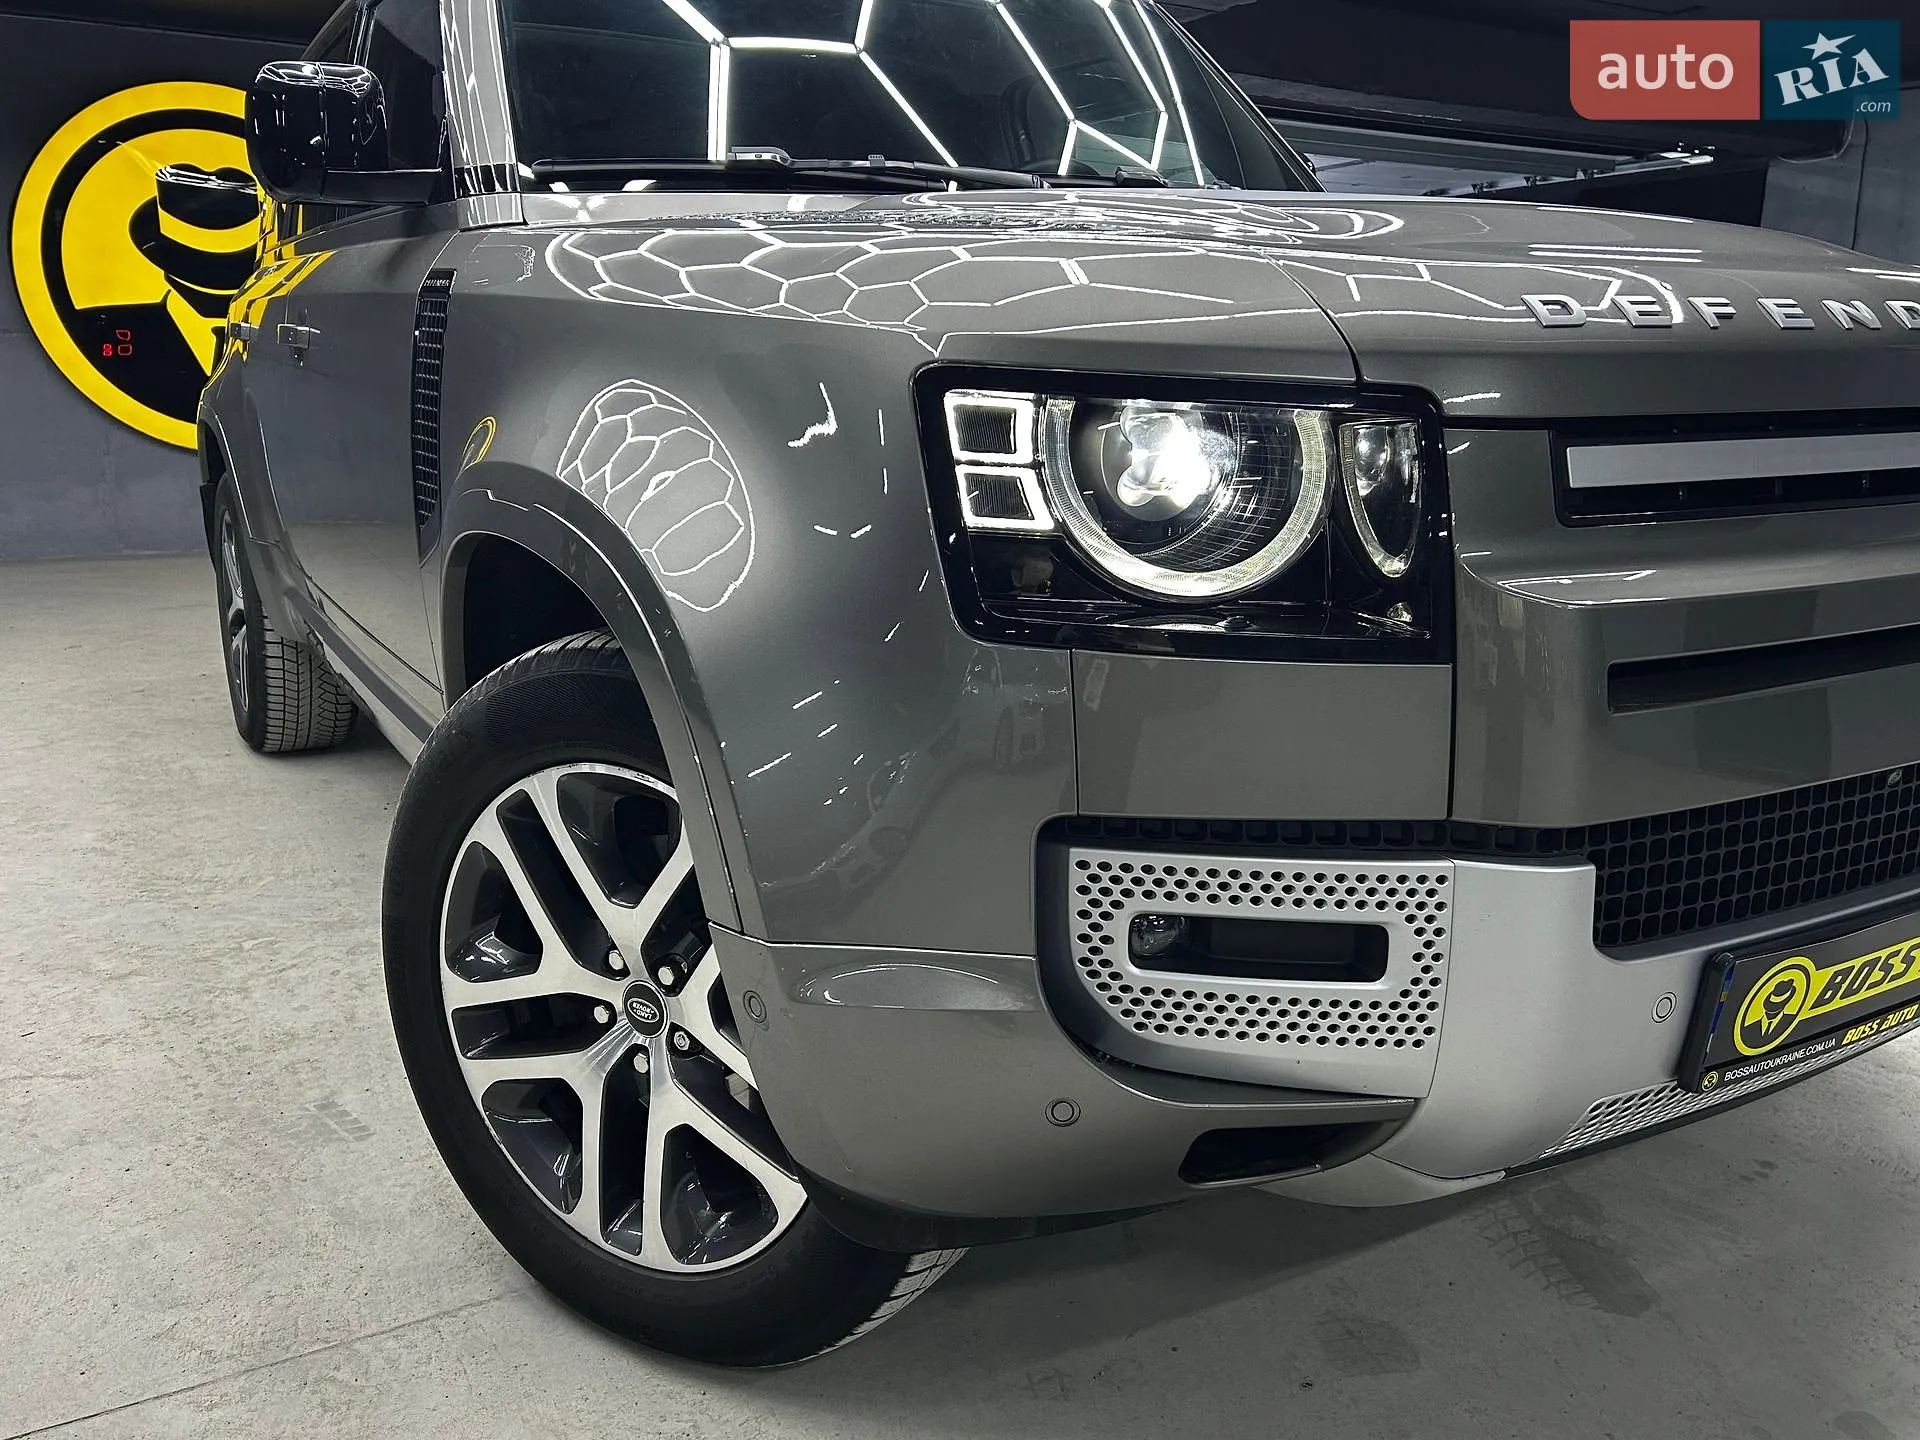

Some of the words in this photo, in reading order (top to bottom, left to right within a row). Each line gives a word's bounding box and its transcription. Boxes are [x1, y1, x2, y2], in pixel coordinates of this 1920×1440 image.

[1808, 942, 1920, 1011] BOSS
[632, 1002, 651, 1013] ROVER
[636, 1009, 652, 1019] LAND
[1841, 1019, 1880, 1045] BOSS
[1724, 1038, 1836, 1081] BOSSAUTOUKRAINE.COM.UA
